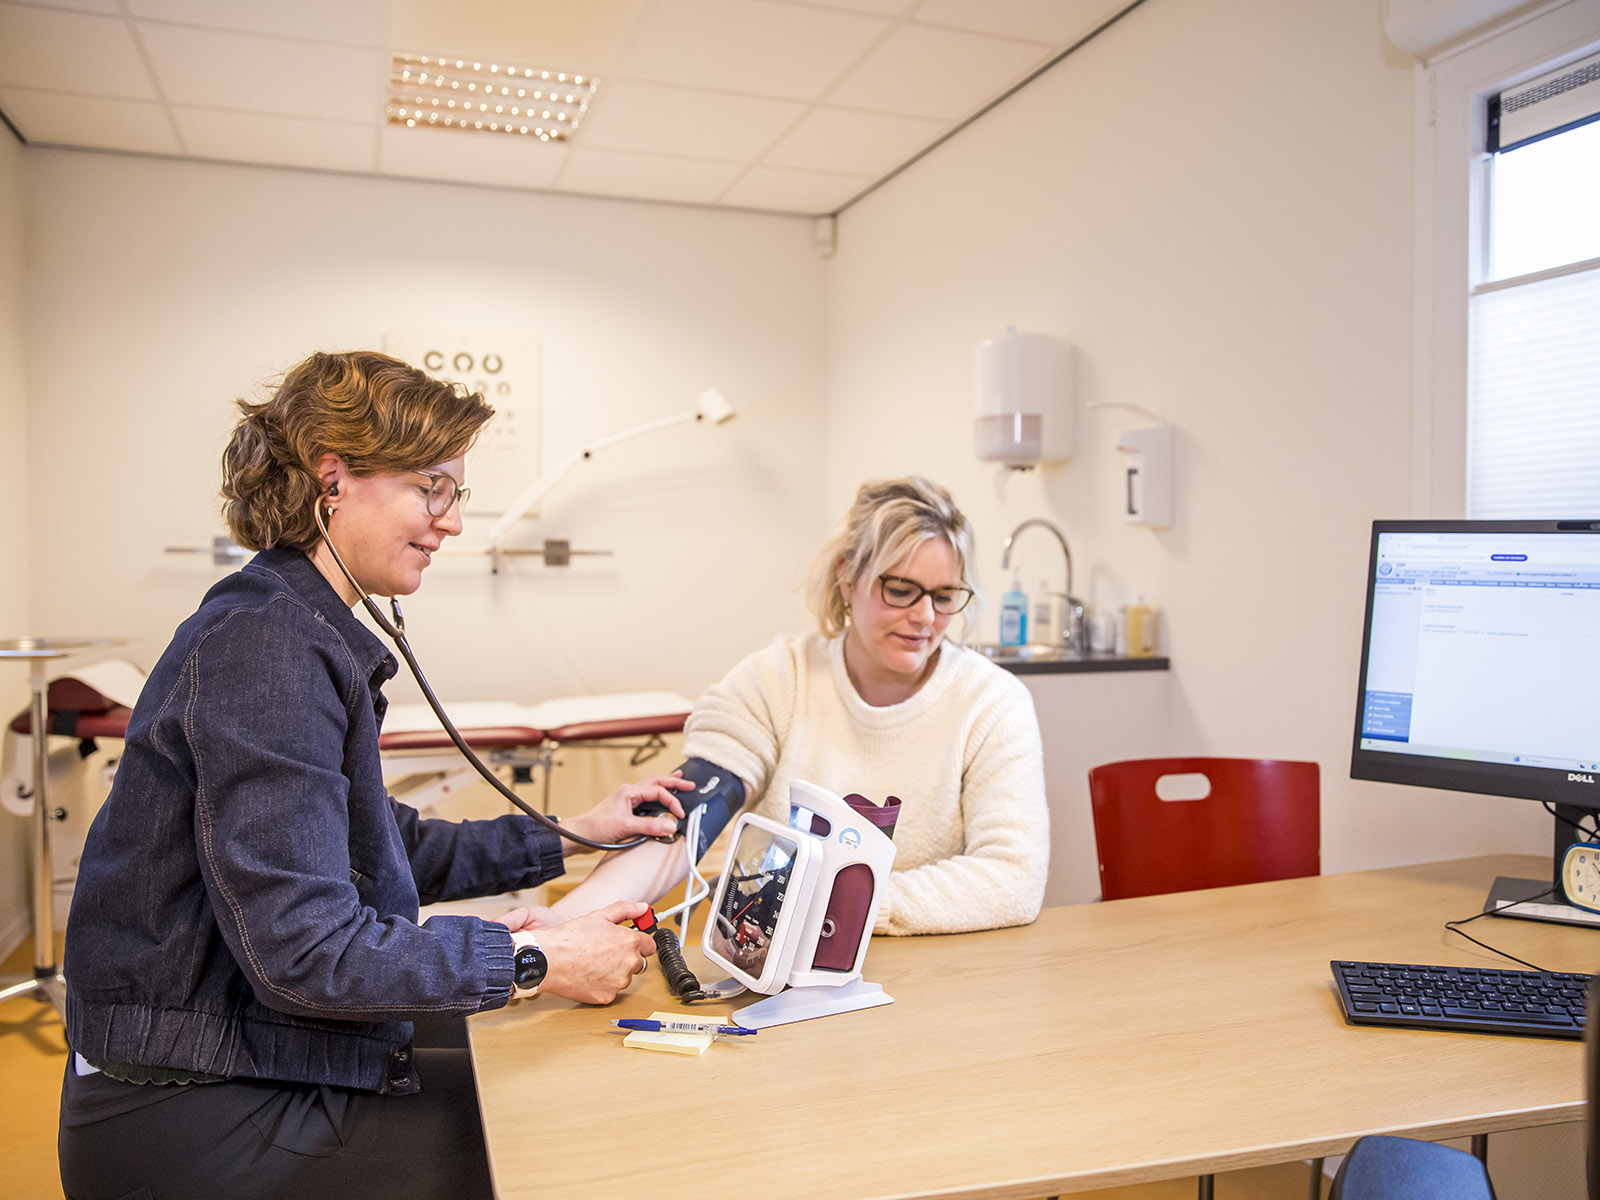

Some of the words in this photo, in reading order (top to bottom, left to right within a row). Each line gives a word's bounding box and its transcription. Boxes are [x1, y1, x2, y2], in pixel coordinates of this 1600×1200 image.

[1567, 773, 1595, 783] DELL
[1576, 869, 1580, 877] 9
[1578, 885, 1583, 893] 8
[777, 892, 785, 902] 22
